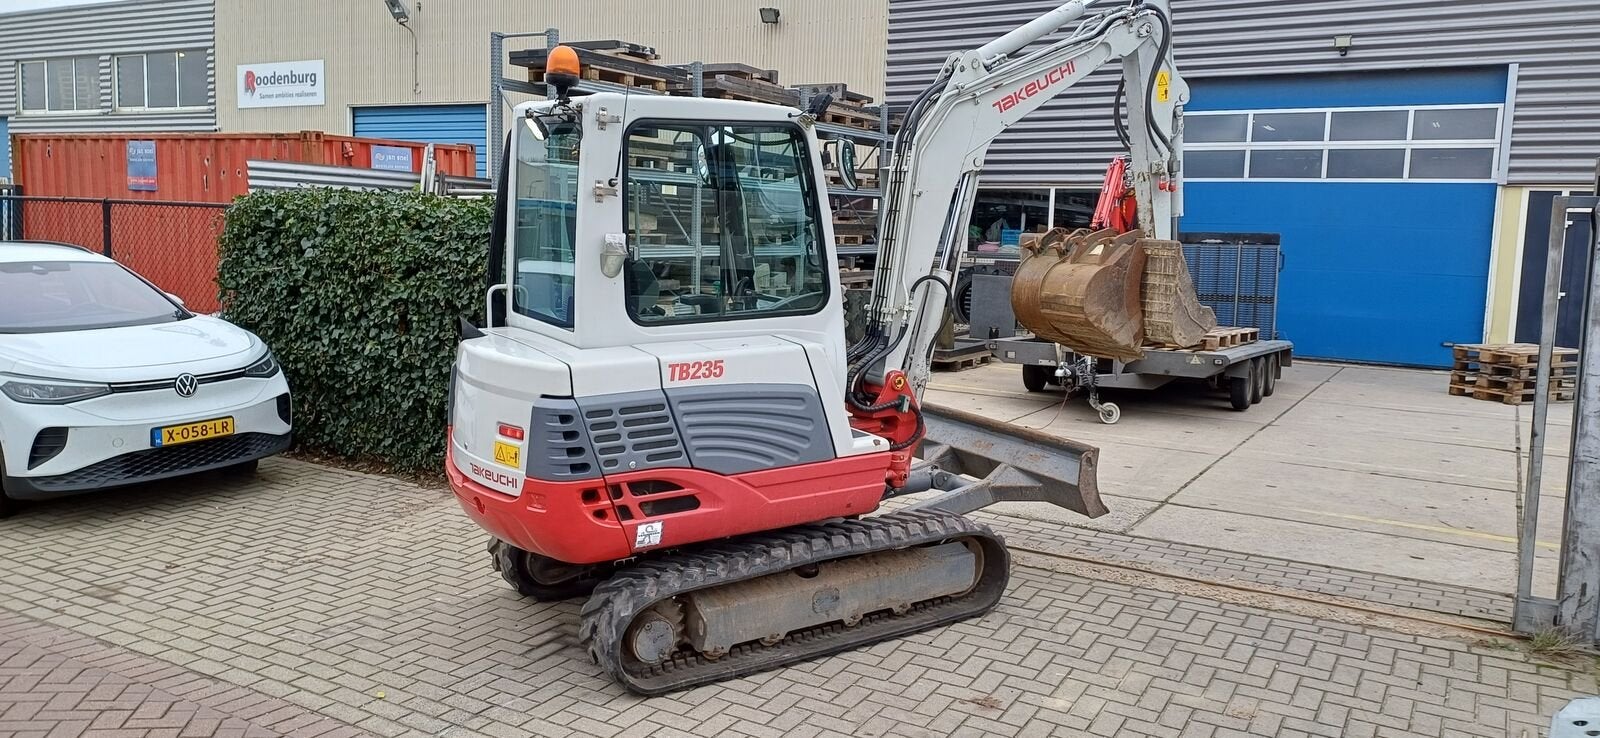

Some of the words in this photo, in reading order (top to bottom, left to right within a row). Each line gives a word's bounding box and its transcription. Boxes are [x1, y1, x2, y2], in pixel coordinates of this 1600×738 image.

[244, 70, 317, 96] Roodenburg
[668, 360, 724, 381] TB235
[166, 421, 229, 442] X-058-LR
